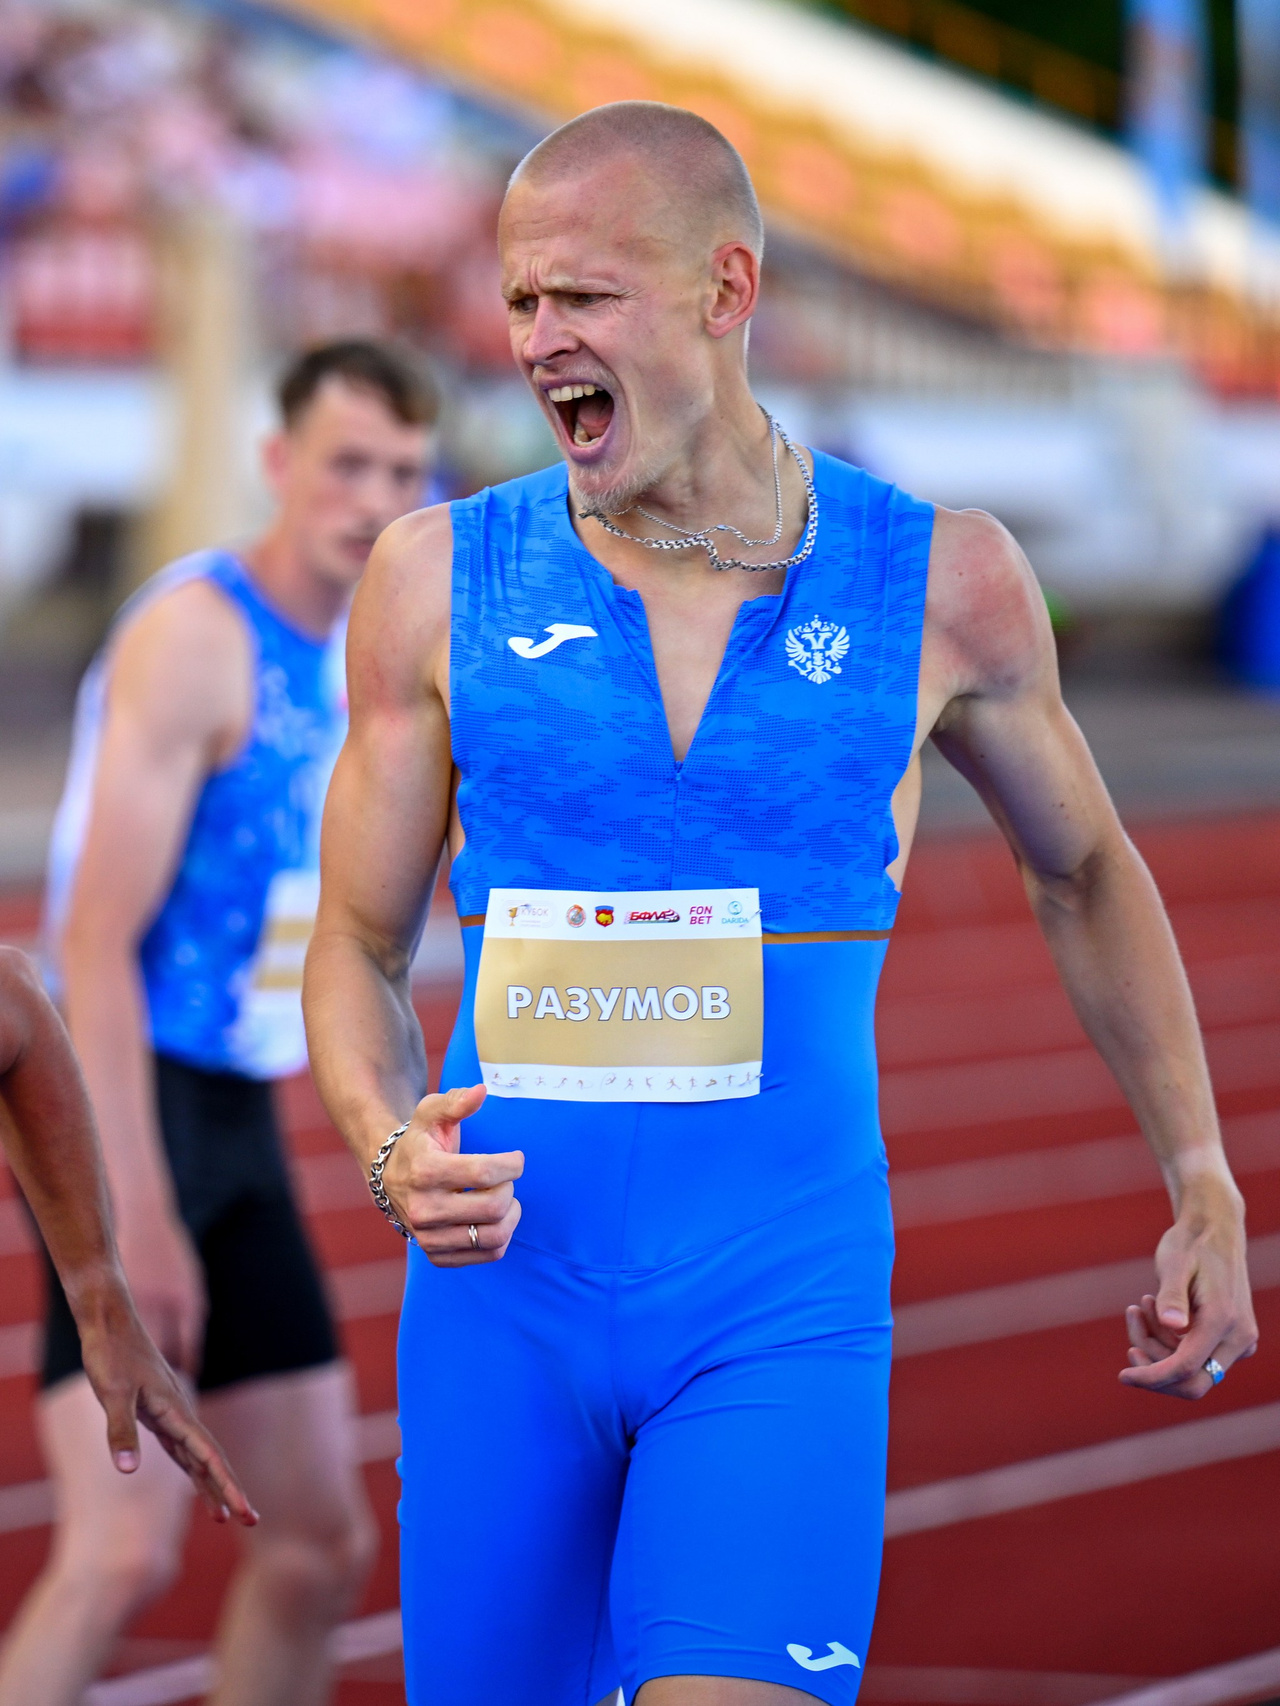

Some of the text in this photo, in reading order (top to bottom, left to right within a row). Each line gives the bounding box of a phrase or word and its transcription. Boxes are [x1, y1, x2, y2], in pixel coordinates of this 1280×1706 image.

[689, 905, 713, 915] FON
[689, 916, 713, 925] BET
[506, 985, 731, 1022] РАЗУМОВ
